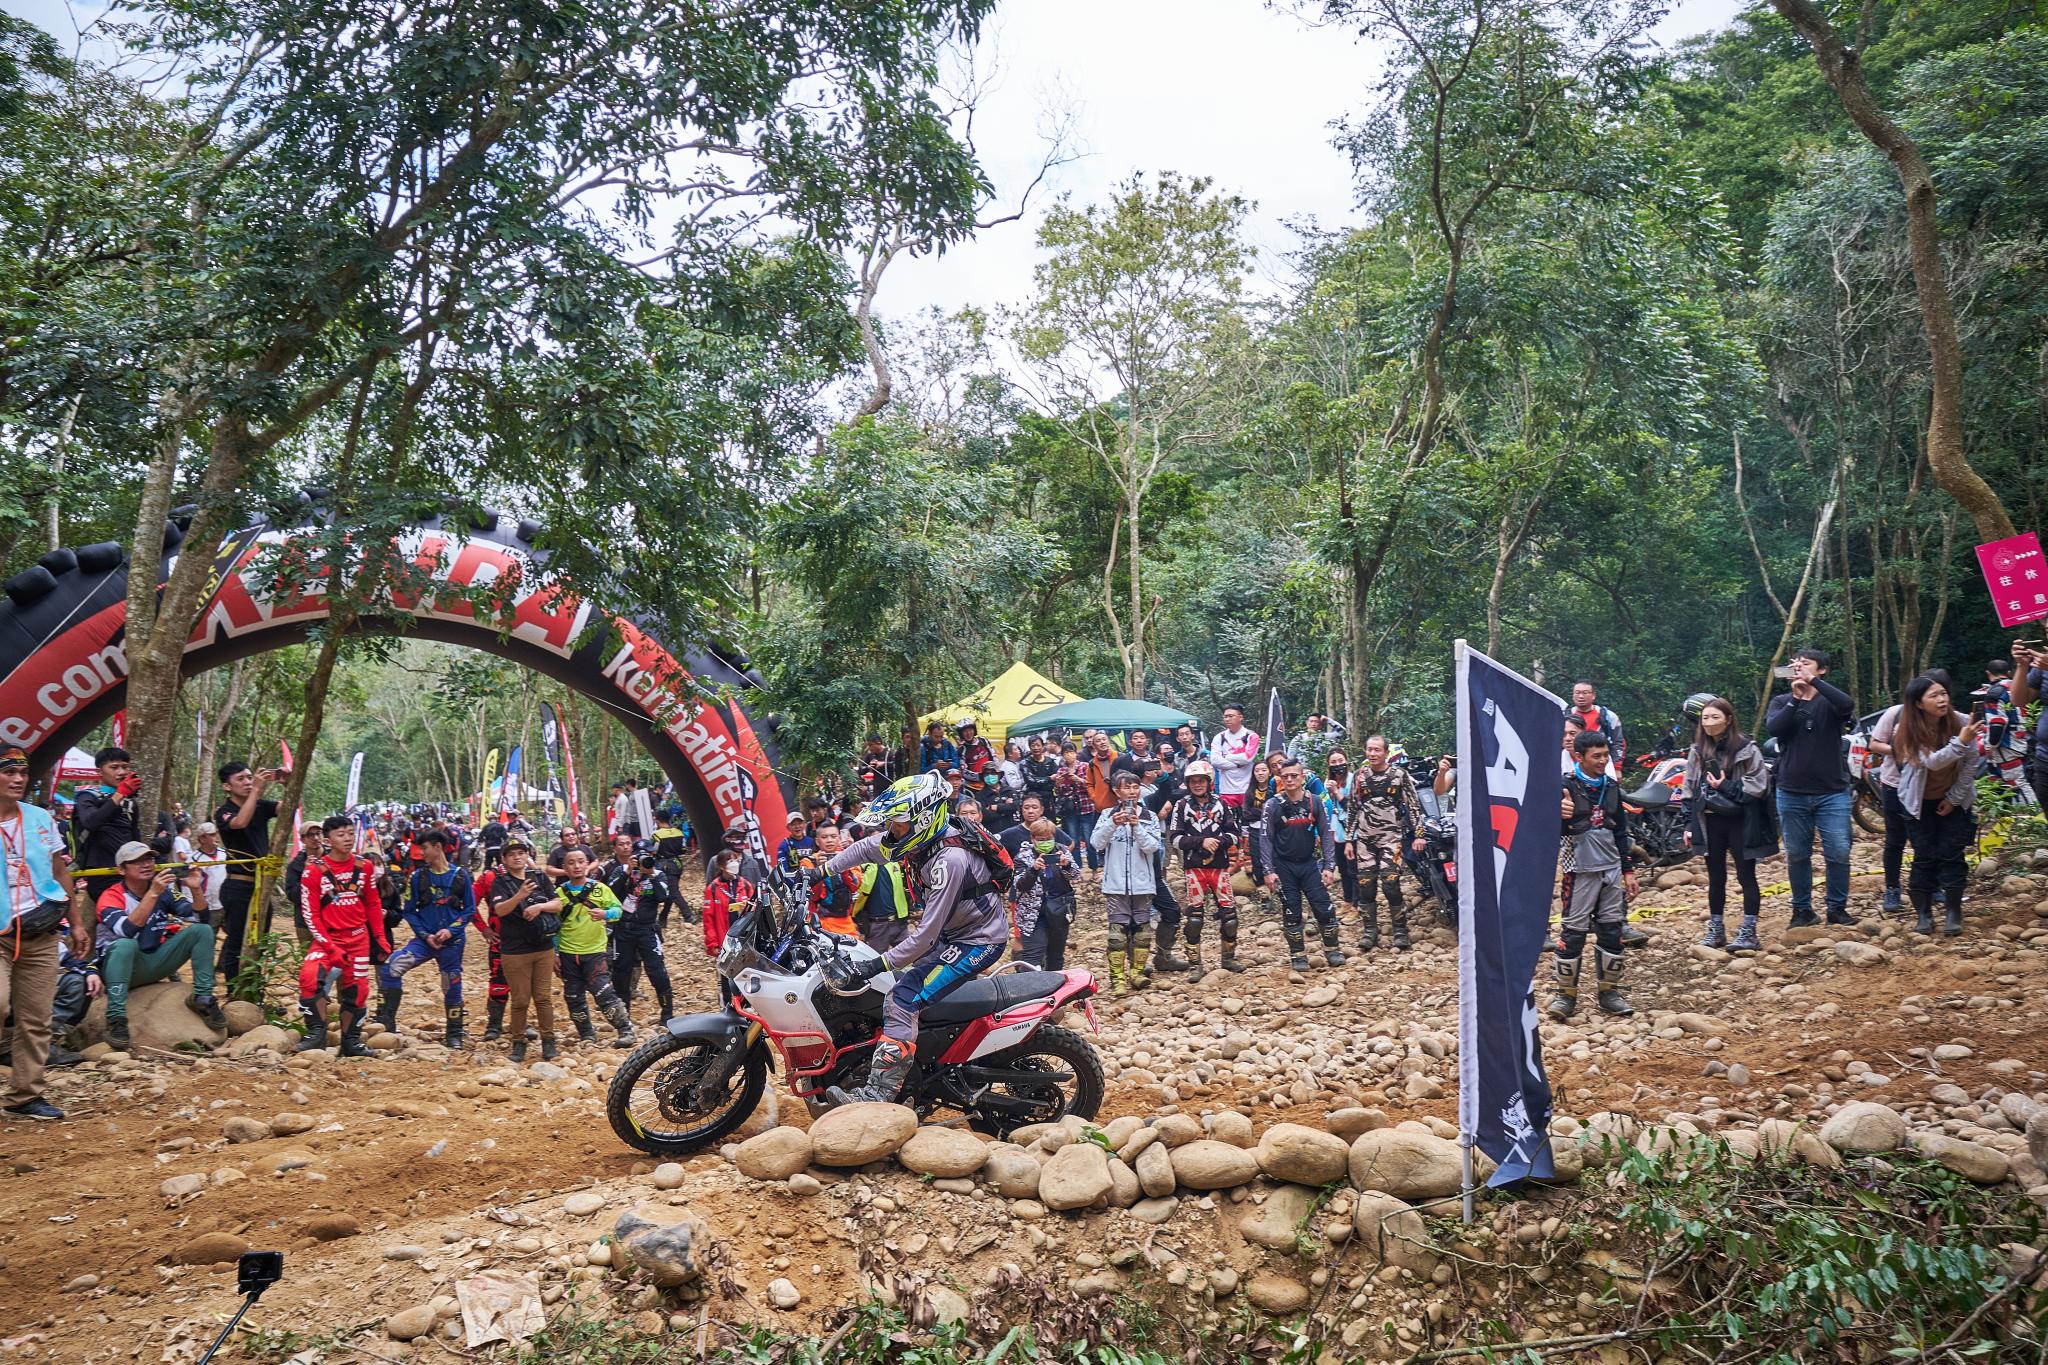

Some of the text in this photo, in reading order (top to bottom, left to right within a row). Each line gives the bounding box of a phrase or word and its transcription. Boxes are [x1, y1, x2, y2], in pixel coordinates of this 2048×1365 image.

[908, 789, 942, 819] 100%
[920, 812, 934, 827] 137
[1011, 1022, 1031, 1032] YAMAHA
